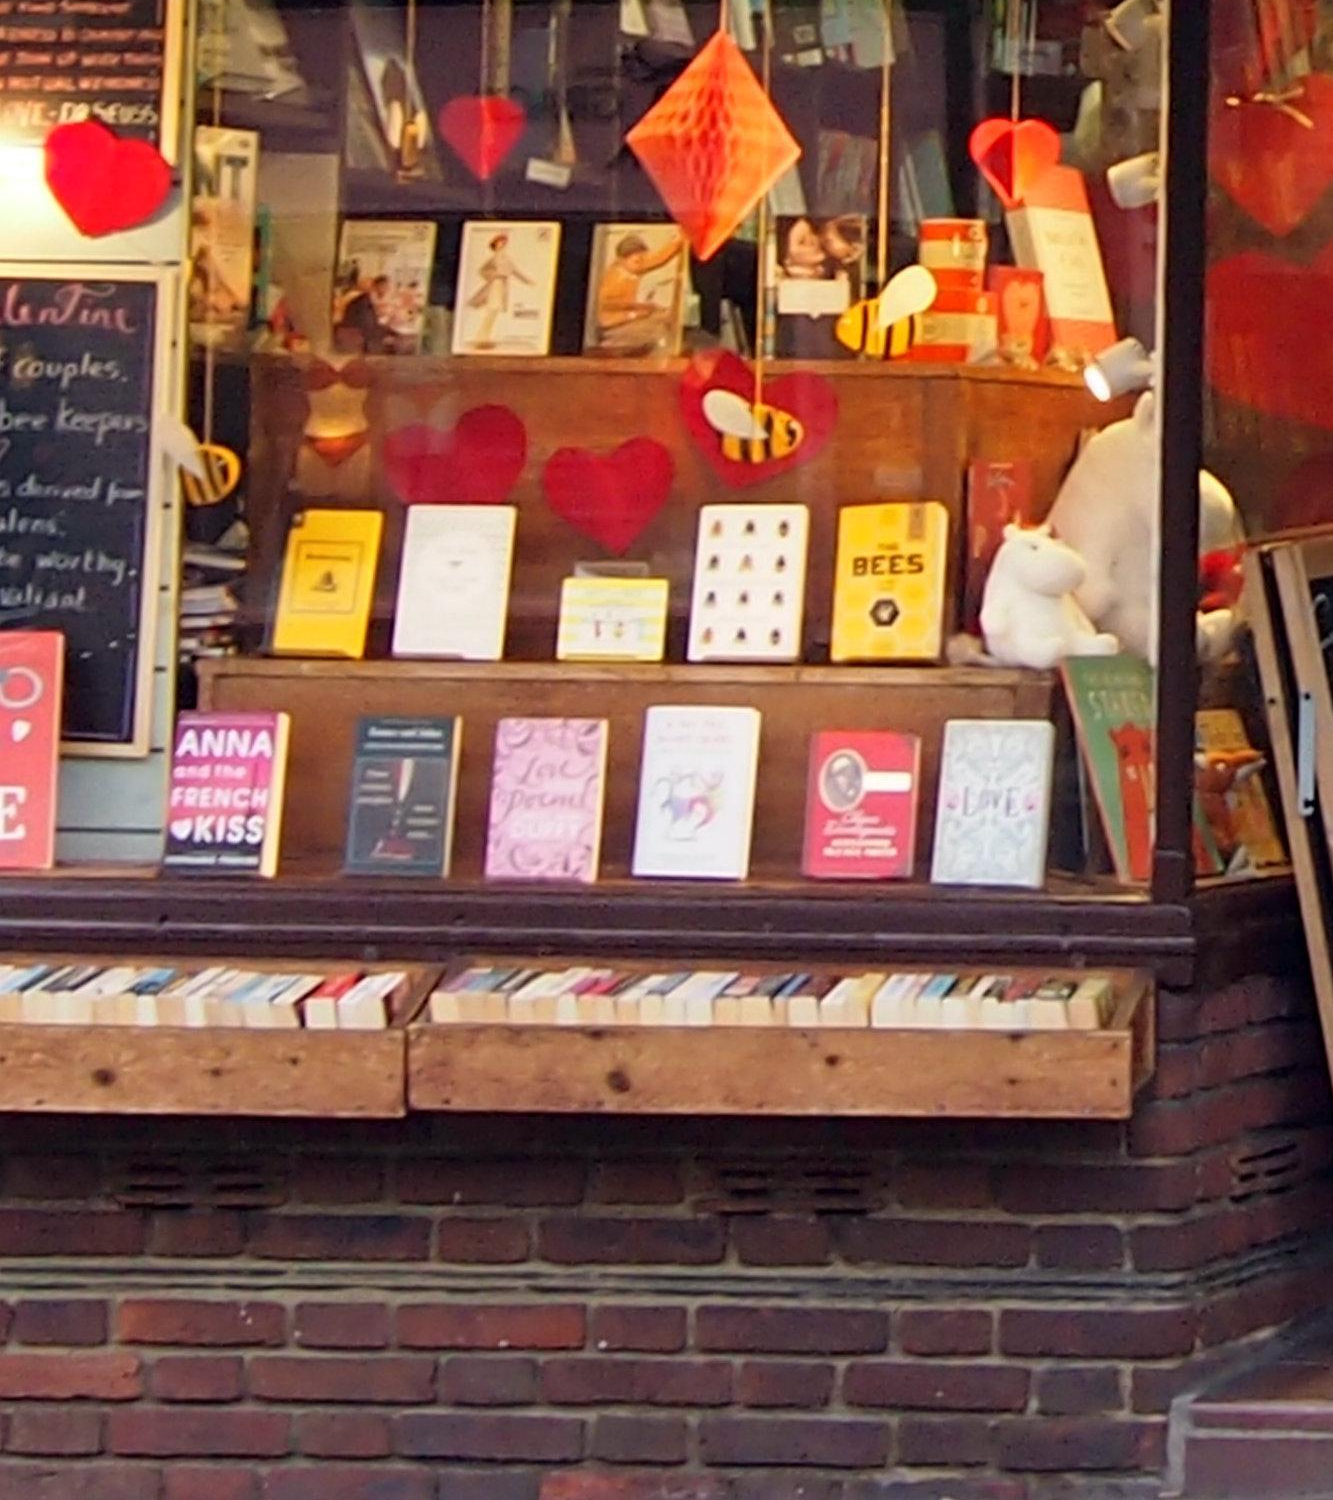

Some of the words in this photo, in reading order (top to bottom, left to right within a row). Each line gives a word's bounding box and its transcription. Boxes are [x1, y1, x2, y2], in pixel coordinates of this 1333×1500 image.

[12, 352, 129, 389] couples.
[852, 553, 925, 577] BEES
[174, 729, 274, 758] ANNA
[173, 764, 212, 780] and
[213, 764, 248, 780] the
[170, 786, 269, 809] FRENCH
[192, 815, 265, 845] KISS
